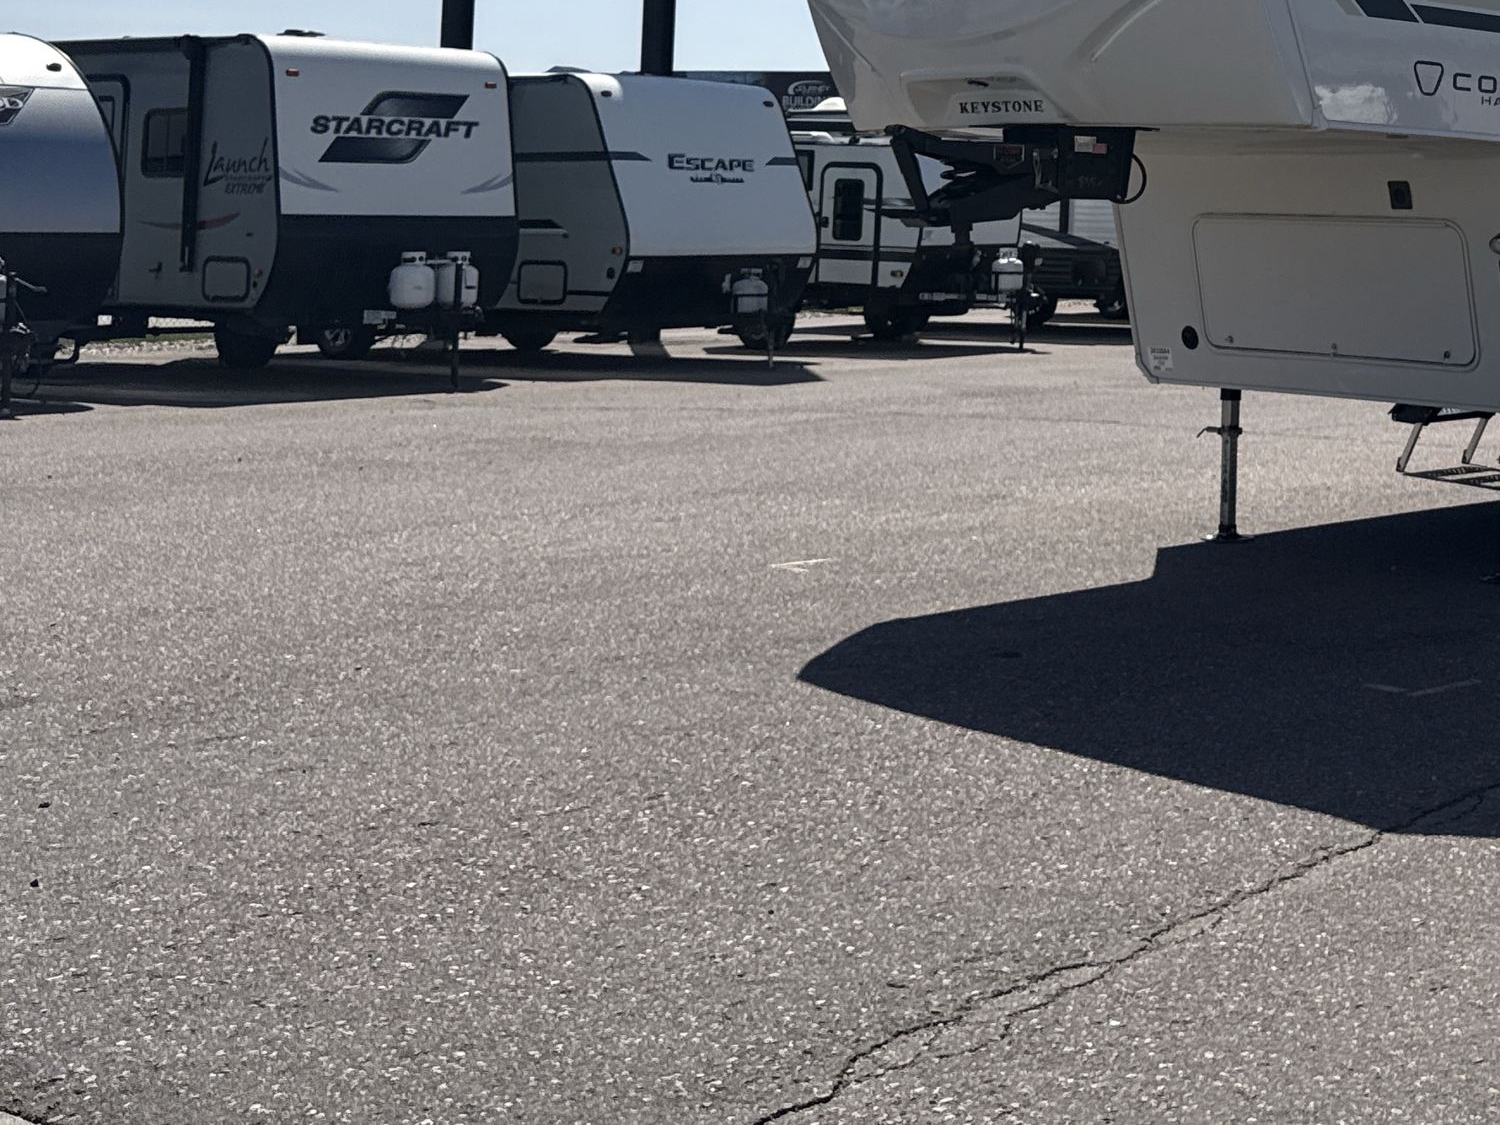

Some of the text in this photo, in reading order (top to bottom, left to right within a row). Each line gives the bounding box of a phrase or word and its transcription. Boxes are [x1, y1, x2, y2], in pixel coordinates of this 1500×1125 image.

[959, 99, 1044, 114] KEYSTONE
[310, 115, 479, 139] STARCRAFT
[203, 138, 270, 187] Launch
